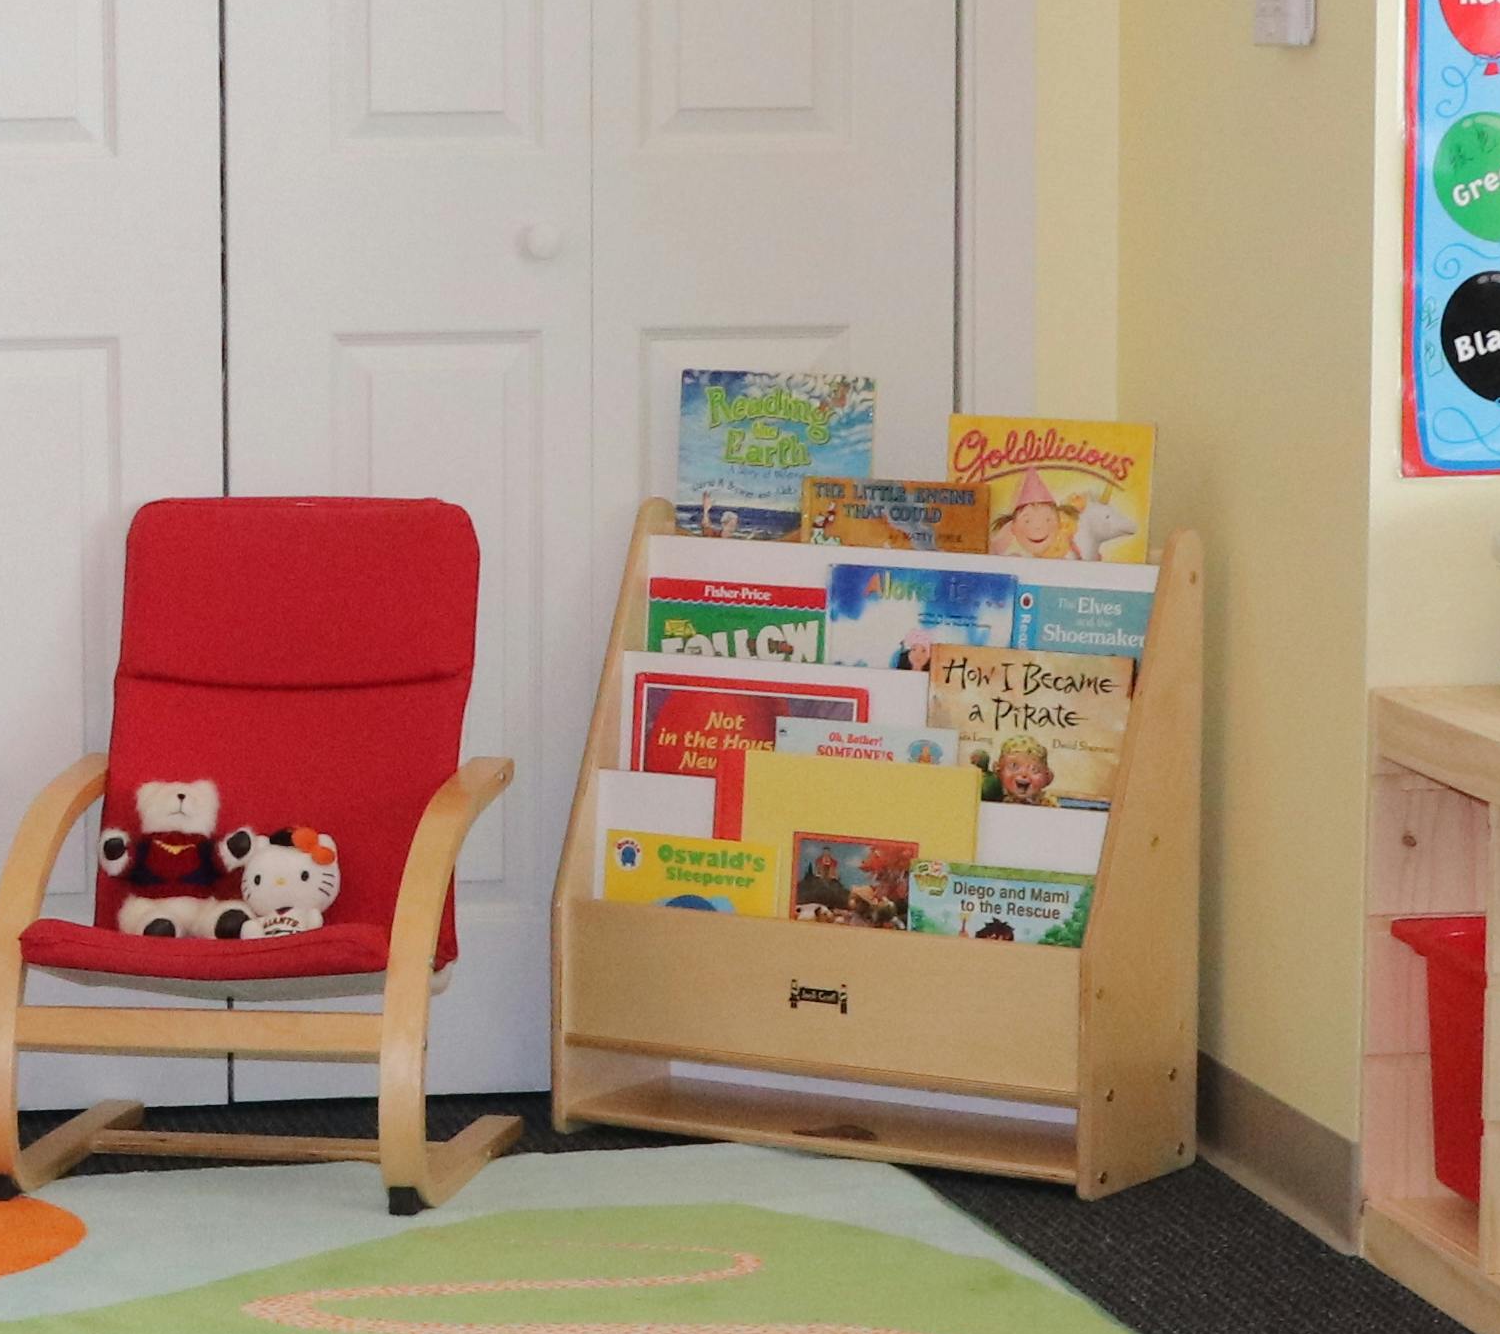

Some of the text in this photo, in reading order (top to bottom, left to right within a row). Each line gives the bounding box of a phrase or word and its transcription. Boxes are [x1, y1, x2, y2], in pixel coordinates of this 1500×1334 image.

[723, 428, 811, 468] Earth
[954, 428, 1134, 483] Goldilicious
[815, 482, 845, 498] THE
[853, 484, 907, 502] LITTLE
[914, 488, 975, 506] ENGINE
[842, 504, 942, 523] THAT COULD
[704, 585, 772, 601] Fisher-Price
[1078, 597, 1122, 616] Elves
[1043, 624, 1144, 647] Shoemaker
[942, 657, 1119, 695] How I Became
[705, 711, 744, 731] Not
[969, 703, 984, 723] a
[658, 728, 776, 751] in the Hous
[816, 744, 894, 761] SOMEONE'S
[657, 844, 766, 872] Oswald's
[666, 867, 755, 887] Sleepover
[953, 881, 1070, 904] Diego and Mami
[960, 899, 1061, 919] to the Rescue
